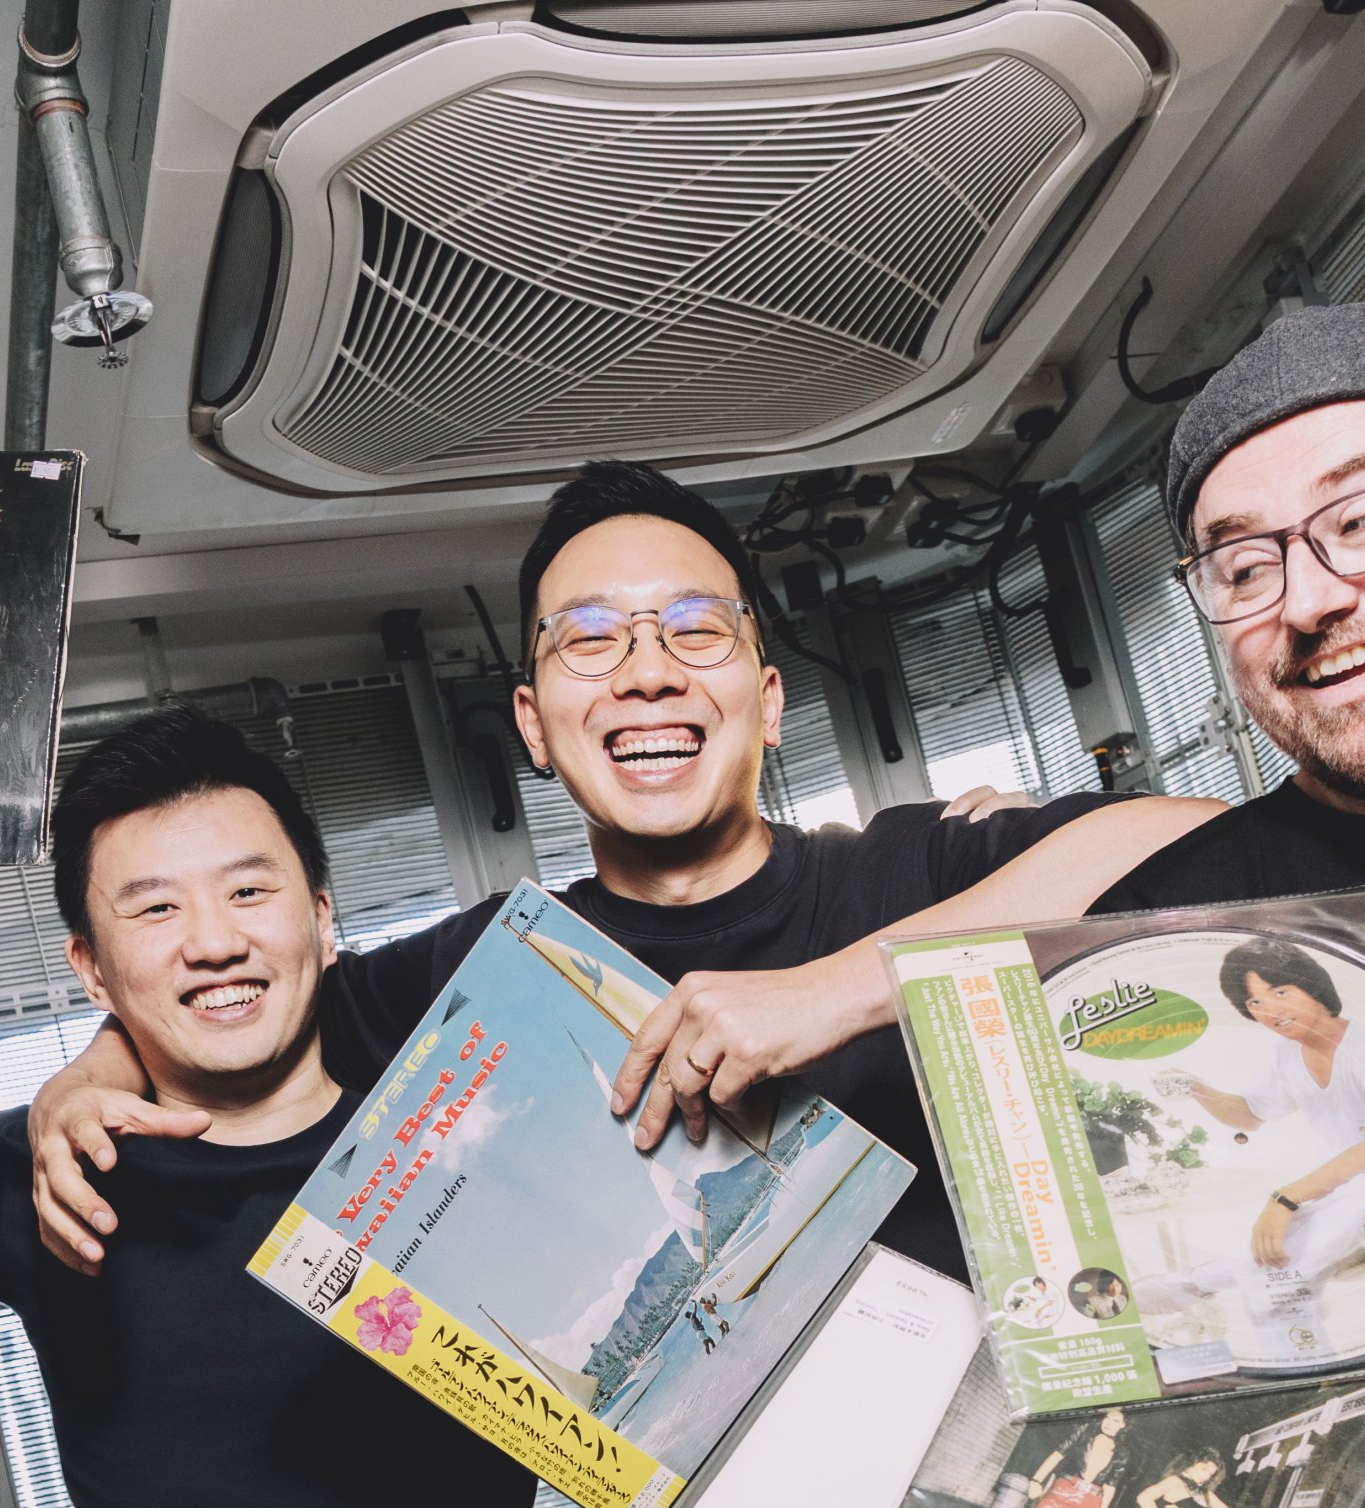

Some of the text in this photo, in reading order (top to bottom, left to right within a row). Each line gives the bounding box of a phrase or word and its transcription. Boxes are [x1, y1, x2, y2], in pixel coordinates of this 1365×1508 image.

[1058, 977, 1156, 1053] Leslie
[1082, 1016, 1206, 1048] DAYDREAMIN'
[352, 1025, 446, 1143] STEREO
[429, 1036, 513, 1141] Music
[333, 1018, 492, 1229] Very Best of
[416, 1170, 470, 1236] Islanders
[1027, 1156, 1057, 1207] Day
[1012, 1160, 1056, 1269] Dreamin'
[279, 1234, 306, 1267] SWG-7031
[300, 1246, 335, 1289] cameo
[1267, 1269, 1302, 1282] SIDE A
[304, 1244, 365, 1316] STEREO
[1079, 1335, 1102, 1348] 180g
[1094, 1370, 1126, 1385] 1,000
